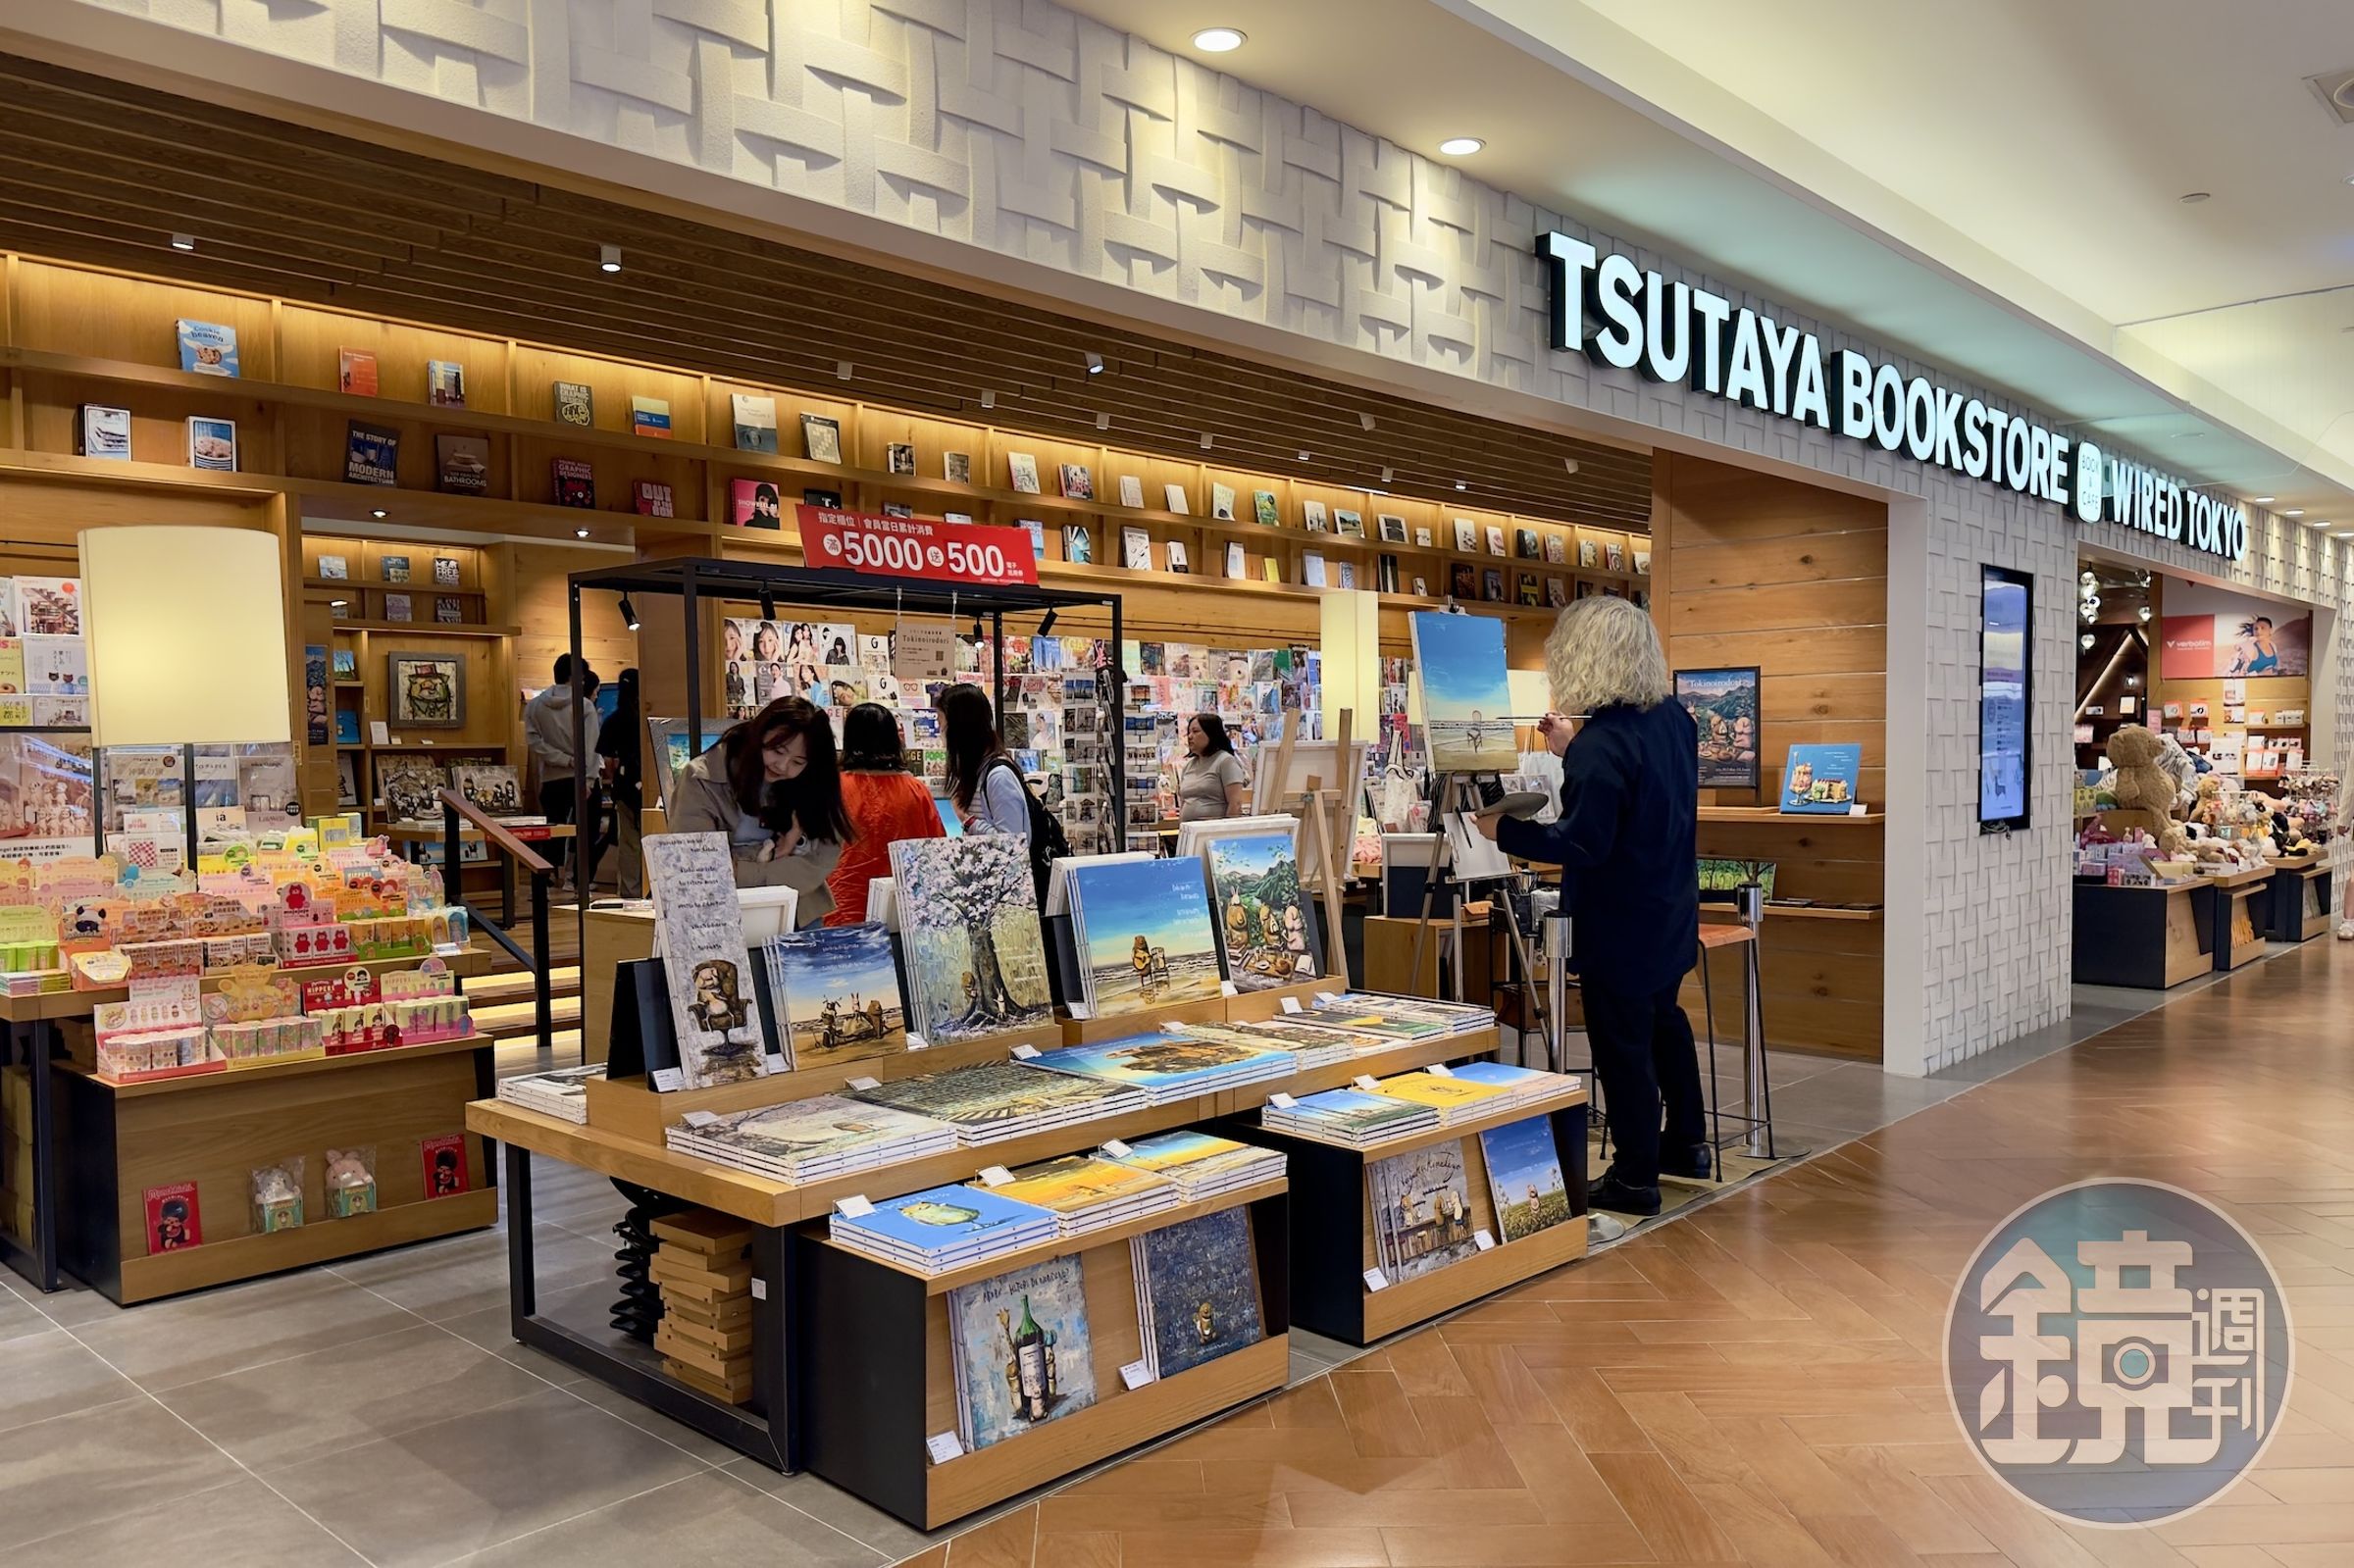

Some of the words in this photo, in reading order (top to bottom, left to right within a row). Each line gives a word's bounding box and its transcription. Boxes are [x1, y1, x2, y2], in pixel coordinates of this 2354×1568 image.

[1548, 230, 1830, 430] TSUTAYA
[1843, 348, 2070, 505] BOOKSTORE
[352, 430, 365, 439] THE
[366, 432, 386, 444] STORY
[348, 462, 394, 479] MODERN
[444, 476, 487, 487] BATHROOMS
[641, 482, 672, 502] OUT
[2112, 459, 2182, 540] WIRED
[2187, 490, 2247, 561] TOKYO
[844, 531, 924, 572] 5000
[947, 541, 1004, 578] 500
